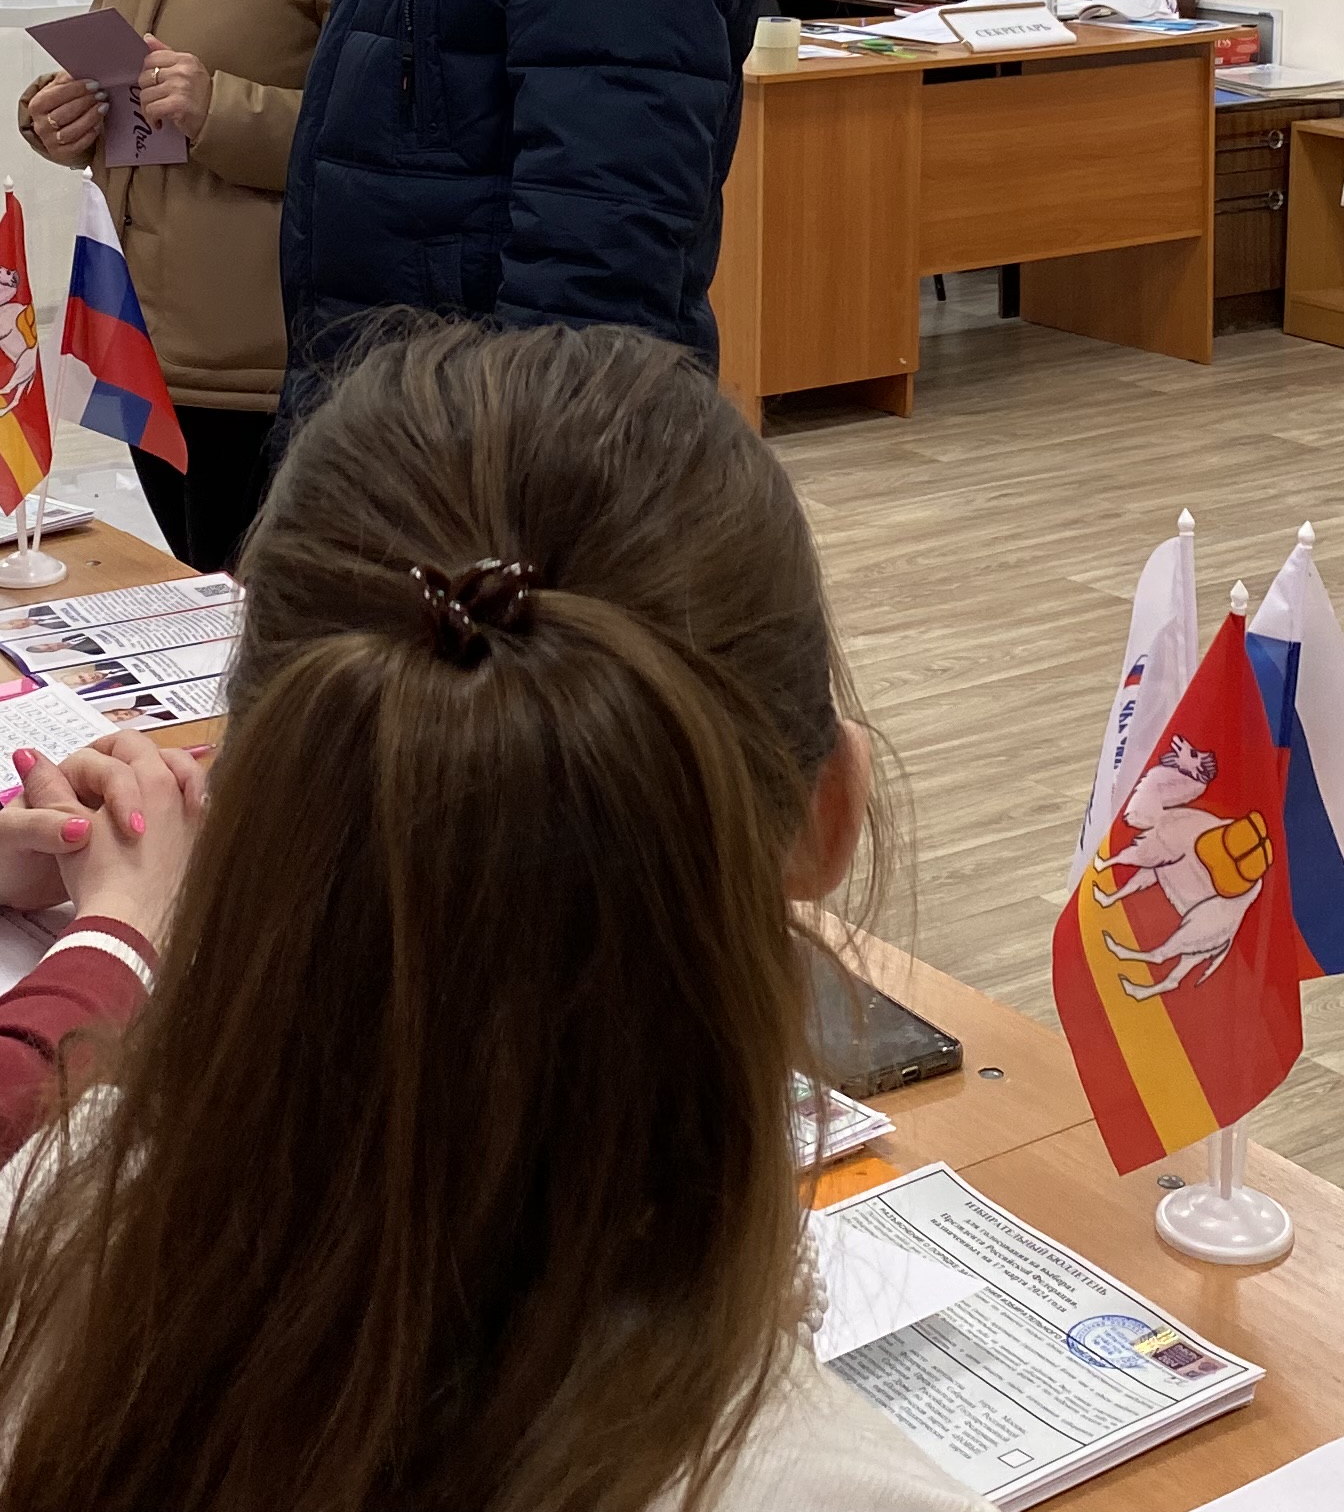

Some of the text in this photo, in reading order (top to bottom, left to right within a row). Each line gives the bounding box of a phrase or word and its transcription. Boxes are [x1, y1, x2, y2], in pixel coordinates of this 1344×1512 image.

[975, 21, 1053, 39] СЕКРЕТАРЬ
[940, 1212, 986, 1246] Президента
[985, 1245, 1033, 1275] Российской
[965, 1201, 1107, 1296] ИЗБИРАТЕЛЬНЫЙ БЮЛЛЕТЕНЬ
[980, 1229, 1029, 1262] голосования
[1040, 1267, 1076, 1293] выборах
[1004, 1269, 1028, 1286] марта
[1027, 1284, 1050, 1300] 2024
